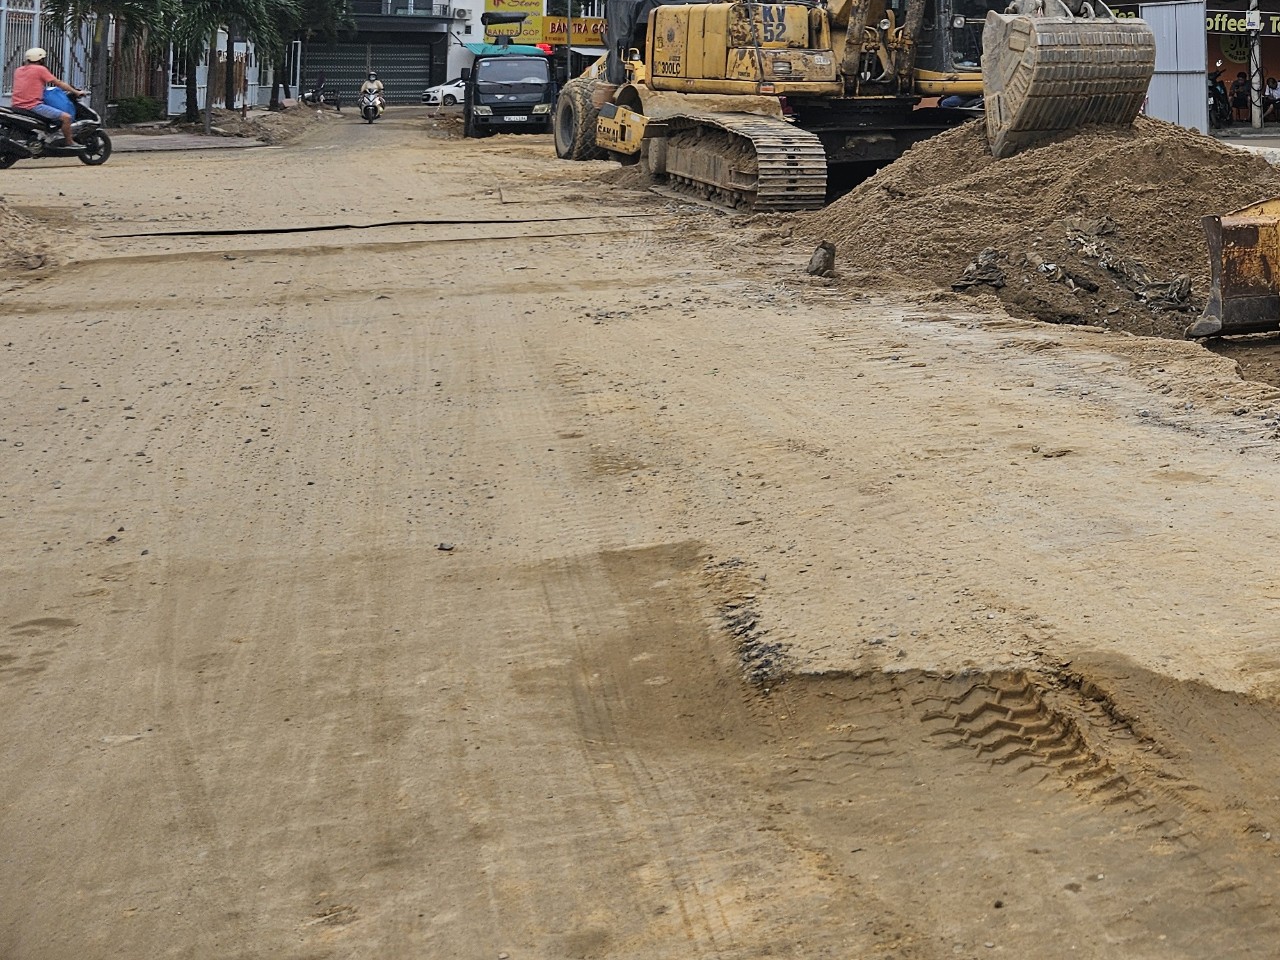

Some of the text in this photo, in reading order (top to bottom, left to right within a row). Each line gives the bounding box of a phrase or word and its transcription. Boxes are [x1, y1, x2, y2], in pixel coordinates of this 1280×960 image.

[762, 5, 786, 23] KV
[1206, 13, 1247, 32] offee
[763, 23, 787, 43] 52
